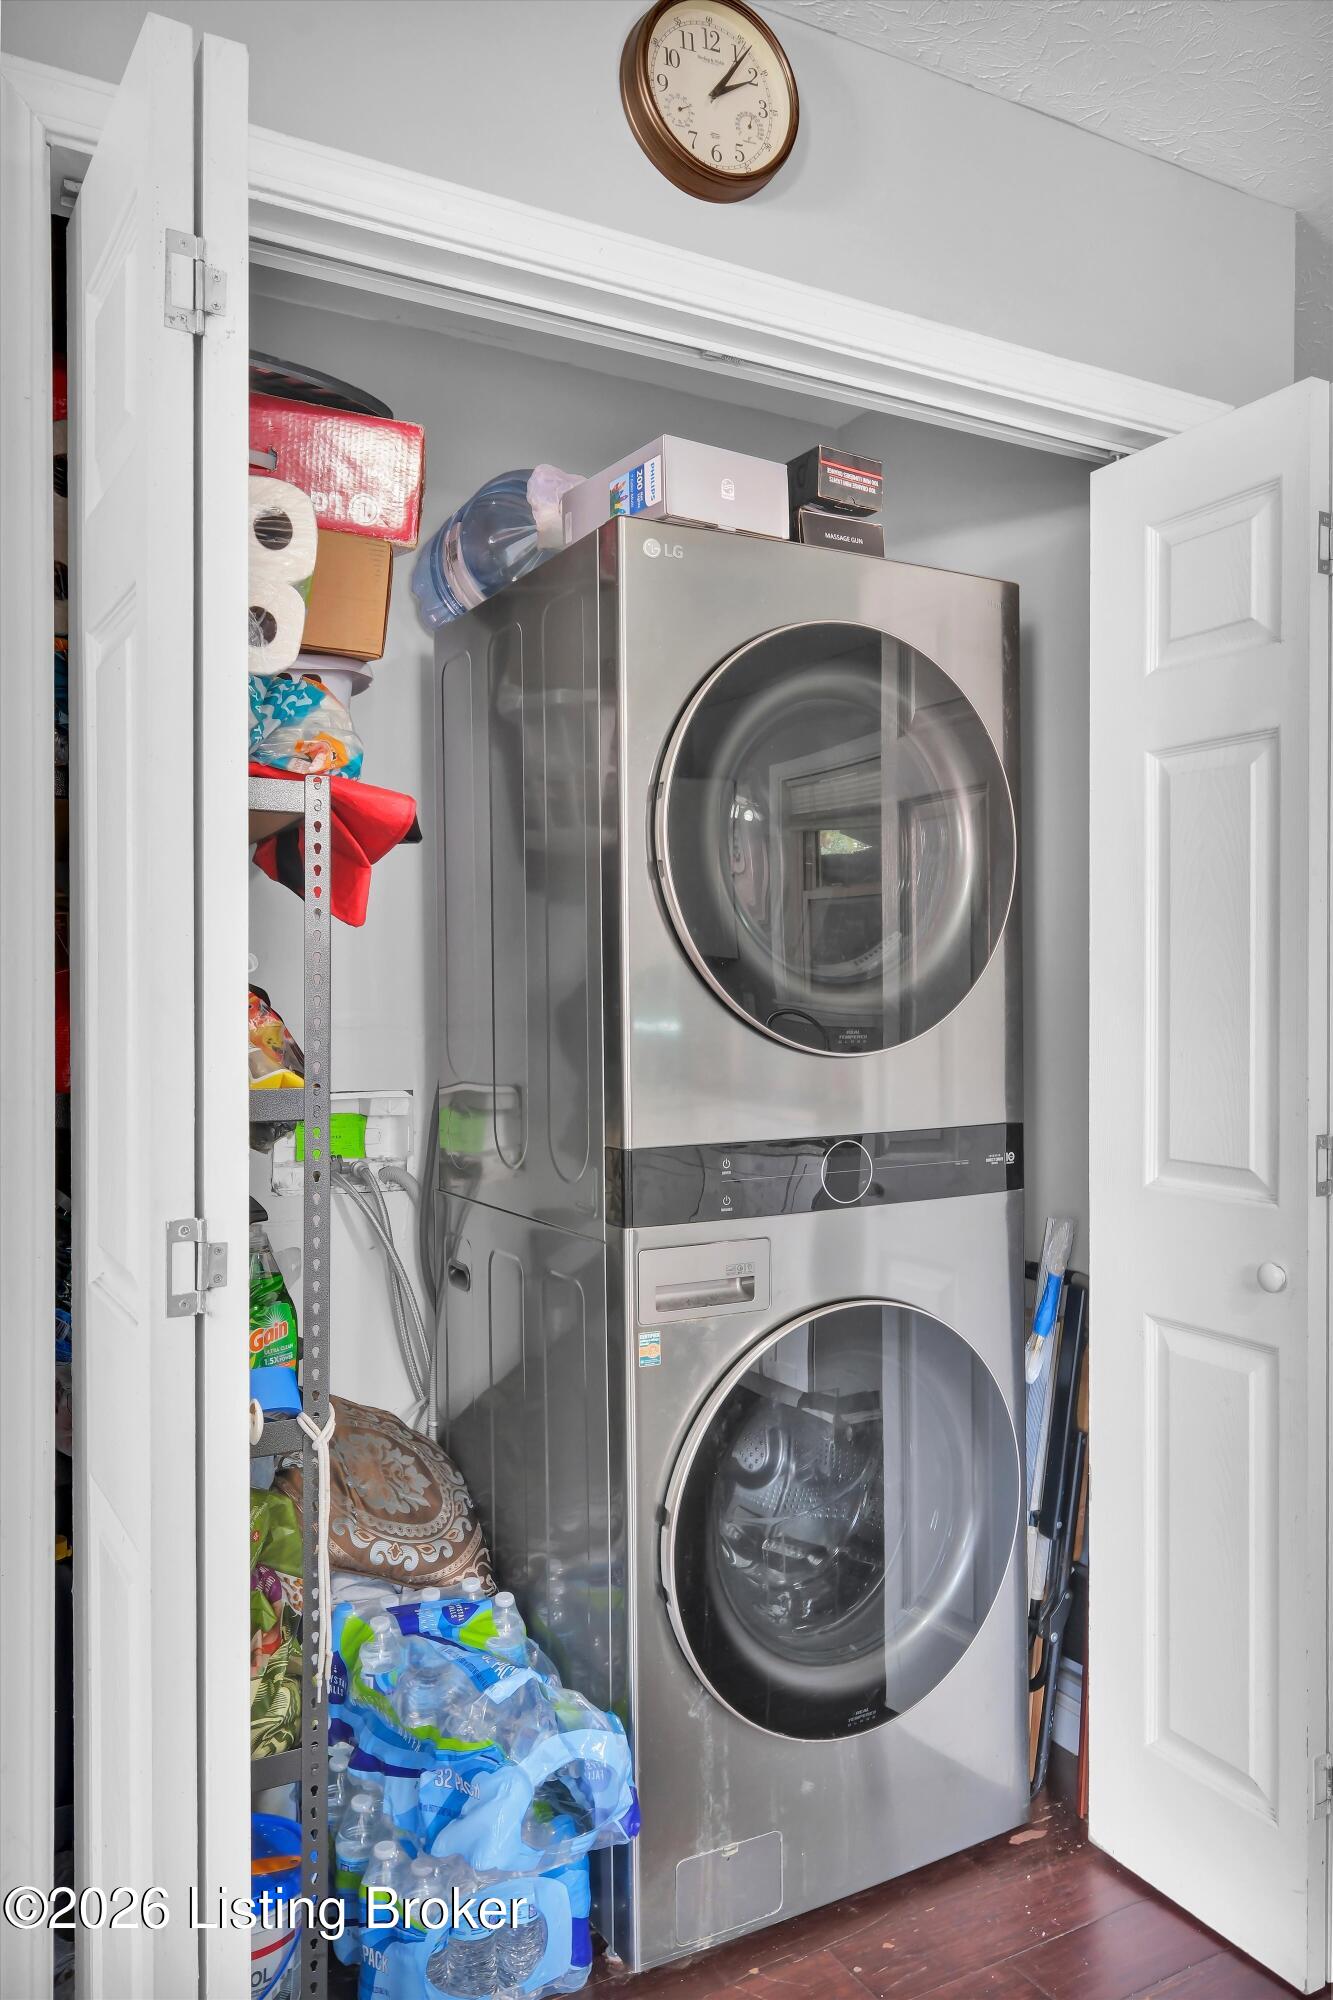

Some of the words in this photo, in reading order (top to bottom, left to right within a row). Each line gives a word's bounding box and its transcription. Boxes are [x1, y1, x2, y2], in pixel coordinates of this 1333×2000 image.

[679, 29, 696, 52] 11
[701, 27, 720, 53] 12
[663, 46, 680, 69] 10
[731, 44, 738, 63] 1
[656, 73, 669, 92] 9
[747, 67, 759, 87] 2
[758, 99, 769, 119] 3
[687, 130, 698, 150] 7
[711, 144, 723, 163] 6
[734, 143, 745, 163] 5
[824, 532, 851, 543] MASSAGE
[850, 536, 864, 545] GUN
[249, 1320, 288, 1353] Gain
[264, 1355, 279, 1366] 1.5X
[434, 1768, 453, 1789] 32
[455, 1773, 481, 1801] PACK
[362, 1944, 390, 1974] PACK
